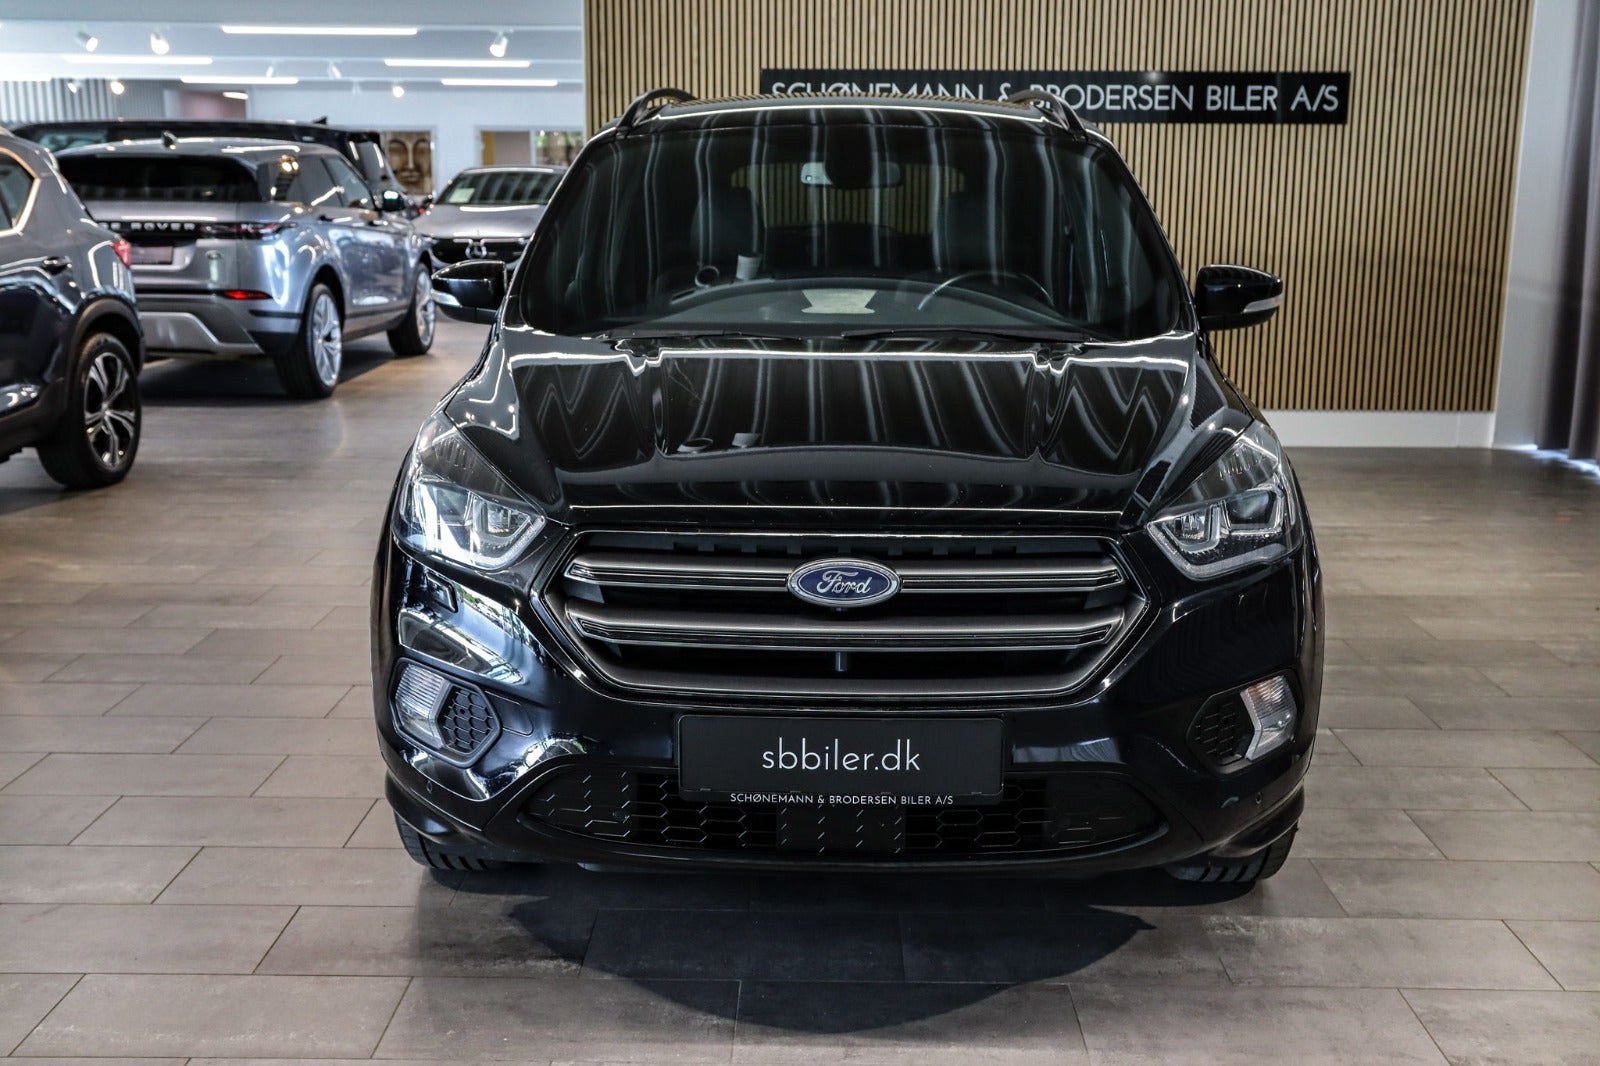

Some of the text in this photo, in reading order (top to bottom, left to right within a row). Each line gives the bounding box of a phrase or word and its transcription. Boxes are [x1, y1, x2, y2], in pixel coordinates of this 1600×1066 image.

[1206, 85, 1278, 111] BILER
[1290, 84, 1339, 112] A/S
[130, 222, 195, 231] ROVER
[816, 570, 873, 594] Ford
[762, 736, 921, 771] sbbiler.dk
[730, 793, 954, 805] SCHØNEMANN & BRODERSEN BILER A/S
